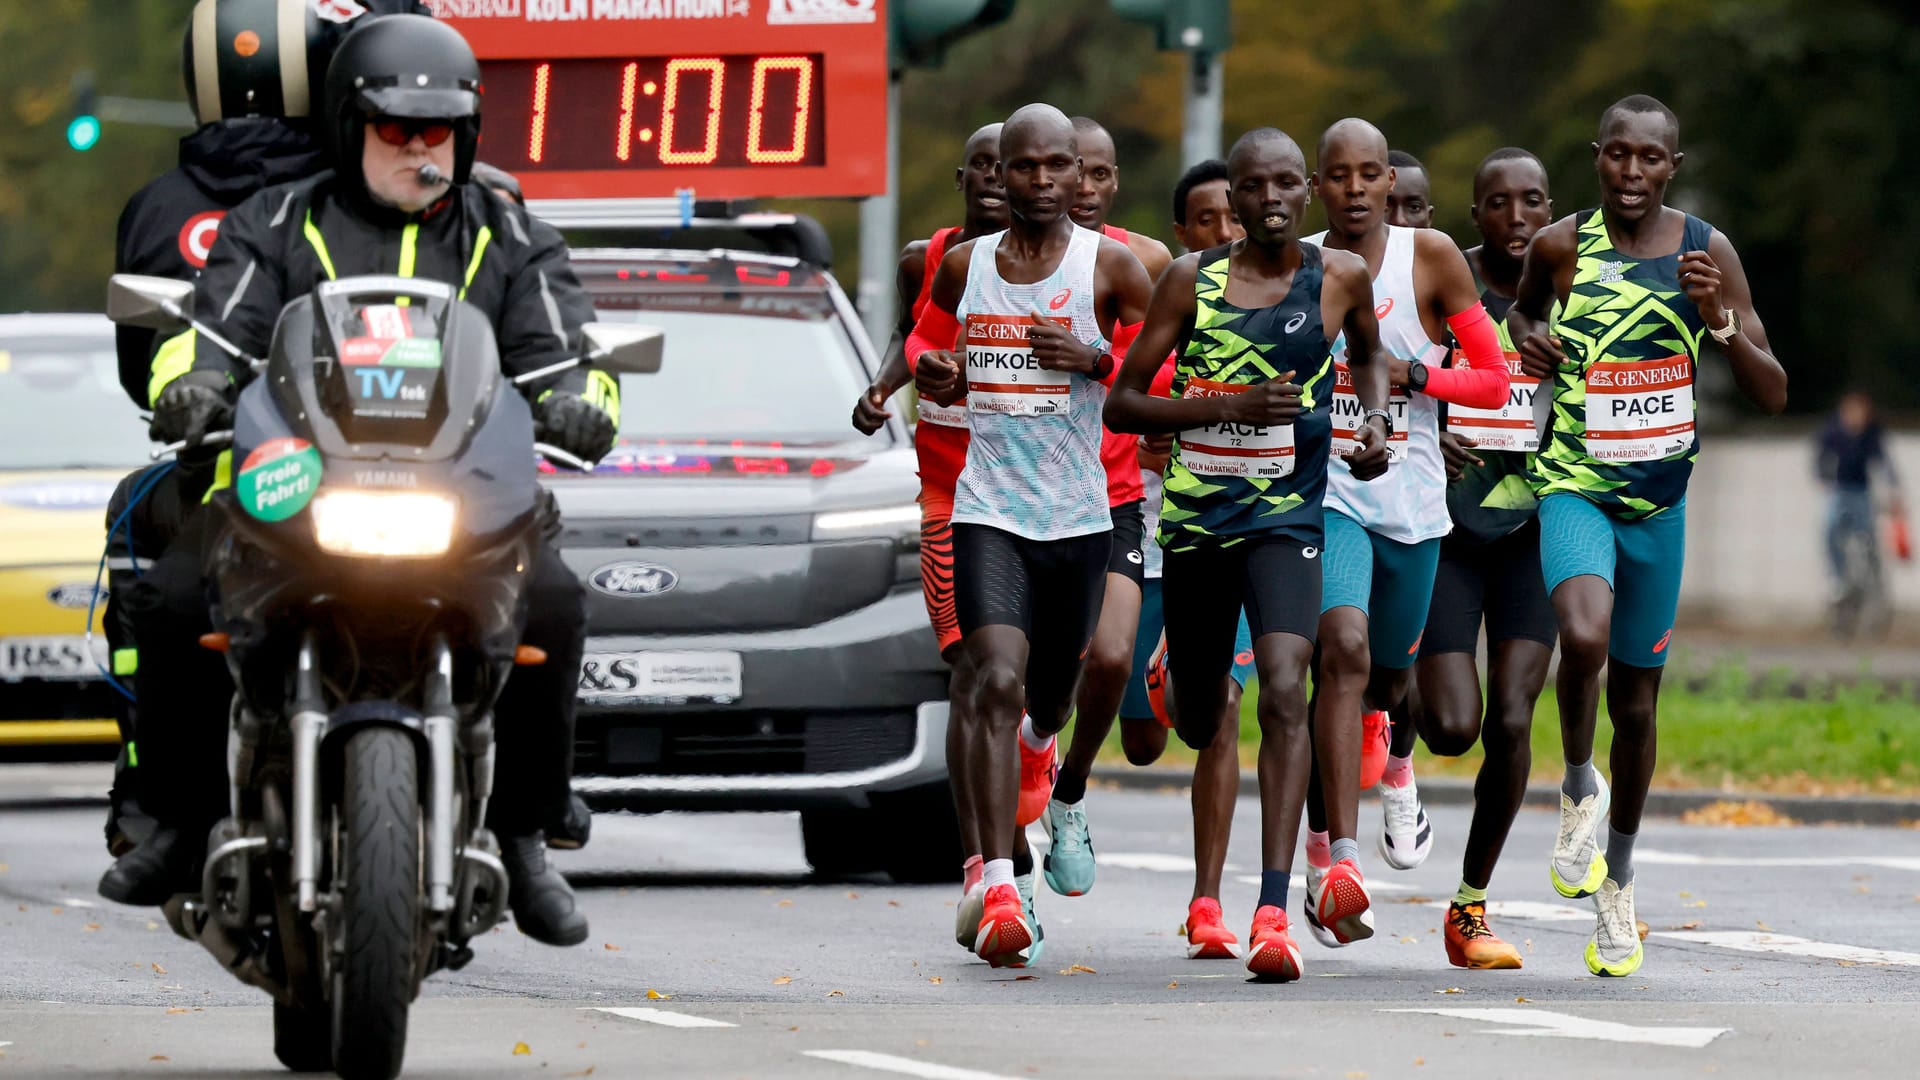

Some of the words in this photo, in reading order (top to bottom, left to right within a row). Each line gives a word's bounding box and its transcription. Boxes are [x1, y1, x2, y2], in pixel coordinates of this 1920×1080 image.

[968, 351, 1040, 370] KIPKOE
[1011, 374, 1018, 382] 3
[1614, 362, 1690, 387] GENERALI
[1034, 405, 1055, 413] PUMA
[1612, 394, 1675, 417] PACE
[1502, 409, 1508, 418] 8
[1348, 420, 1354, 428] 6
[1638, 418, 1649, 427] 71
[1230, 438, 1242, 447] 72
[1524, 440, 1539, 448] PUM
[1612, 449, 1648, 459] MARATHON
[1204, 464, 1239, 474] MARATHON
[1258, 467, 1280, 475] PUMA
[255, 461, 301, 491] Freie
[354, 470, 417, 488] YAMAHA
[256, 474, 309, 511] Fahrt!
[605, 566, 664, 593] Ford
[579, 658, 639, 690] &S
